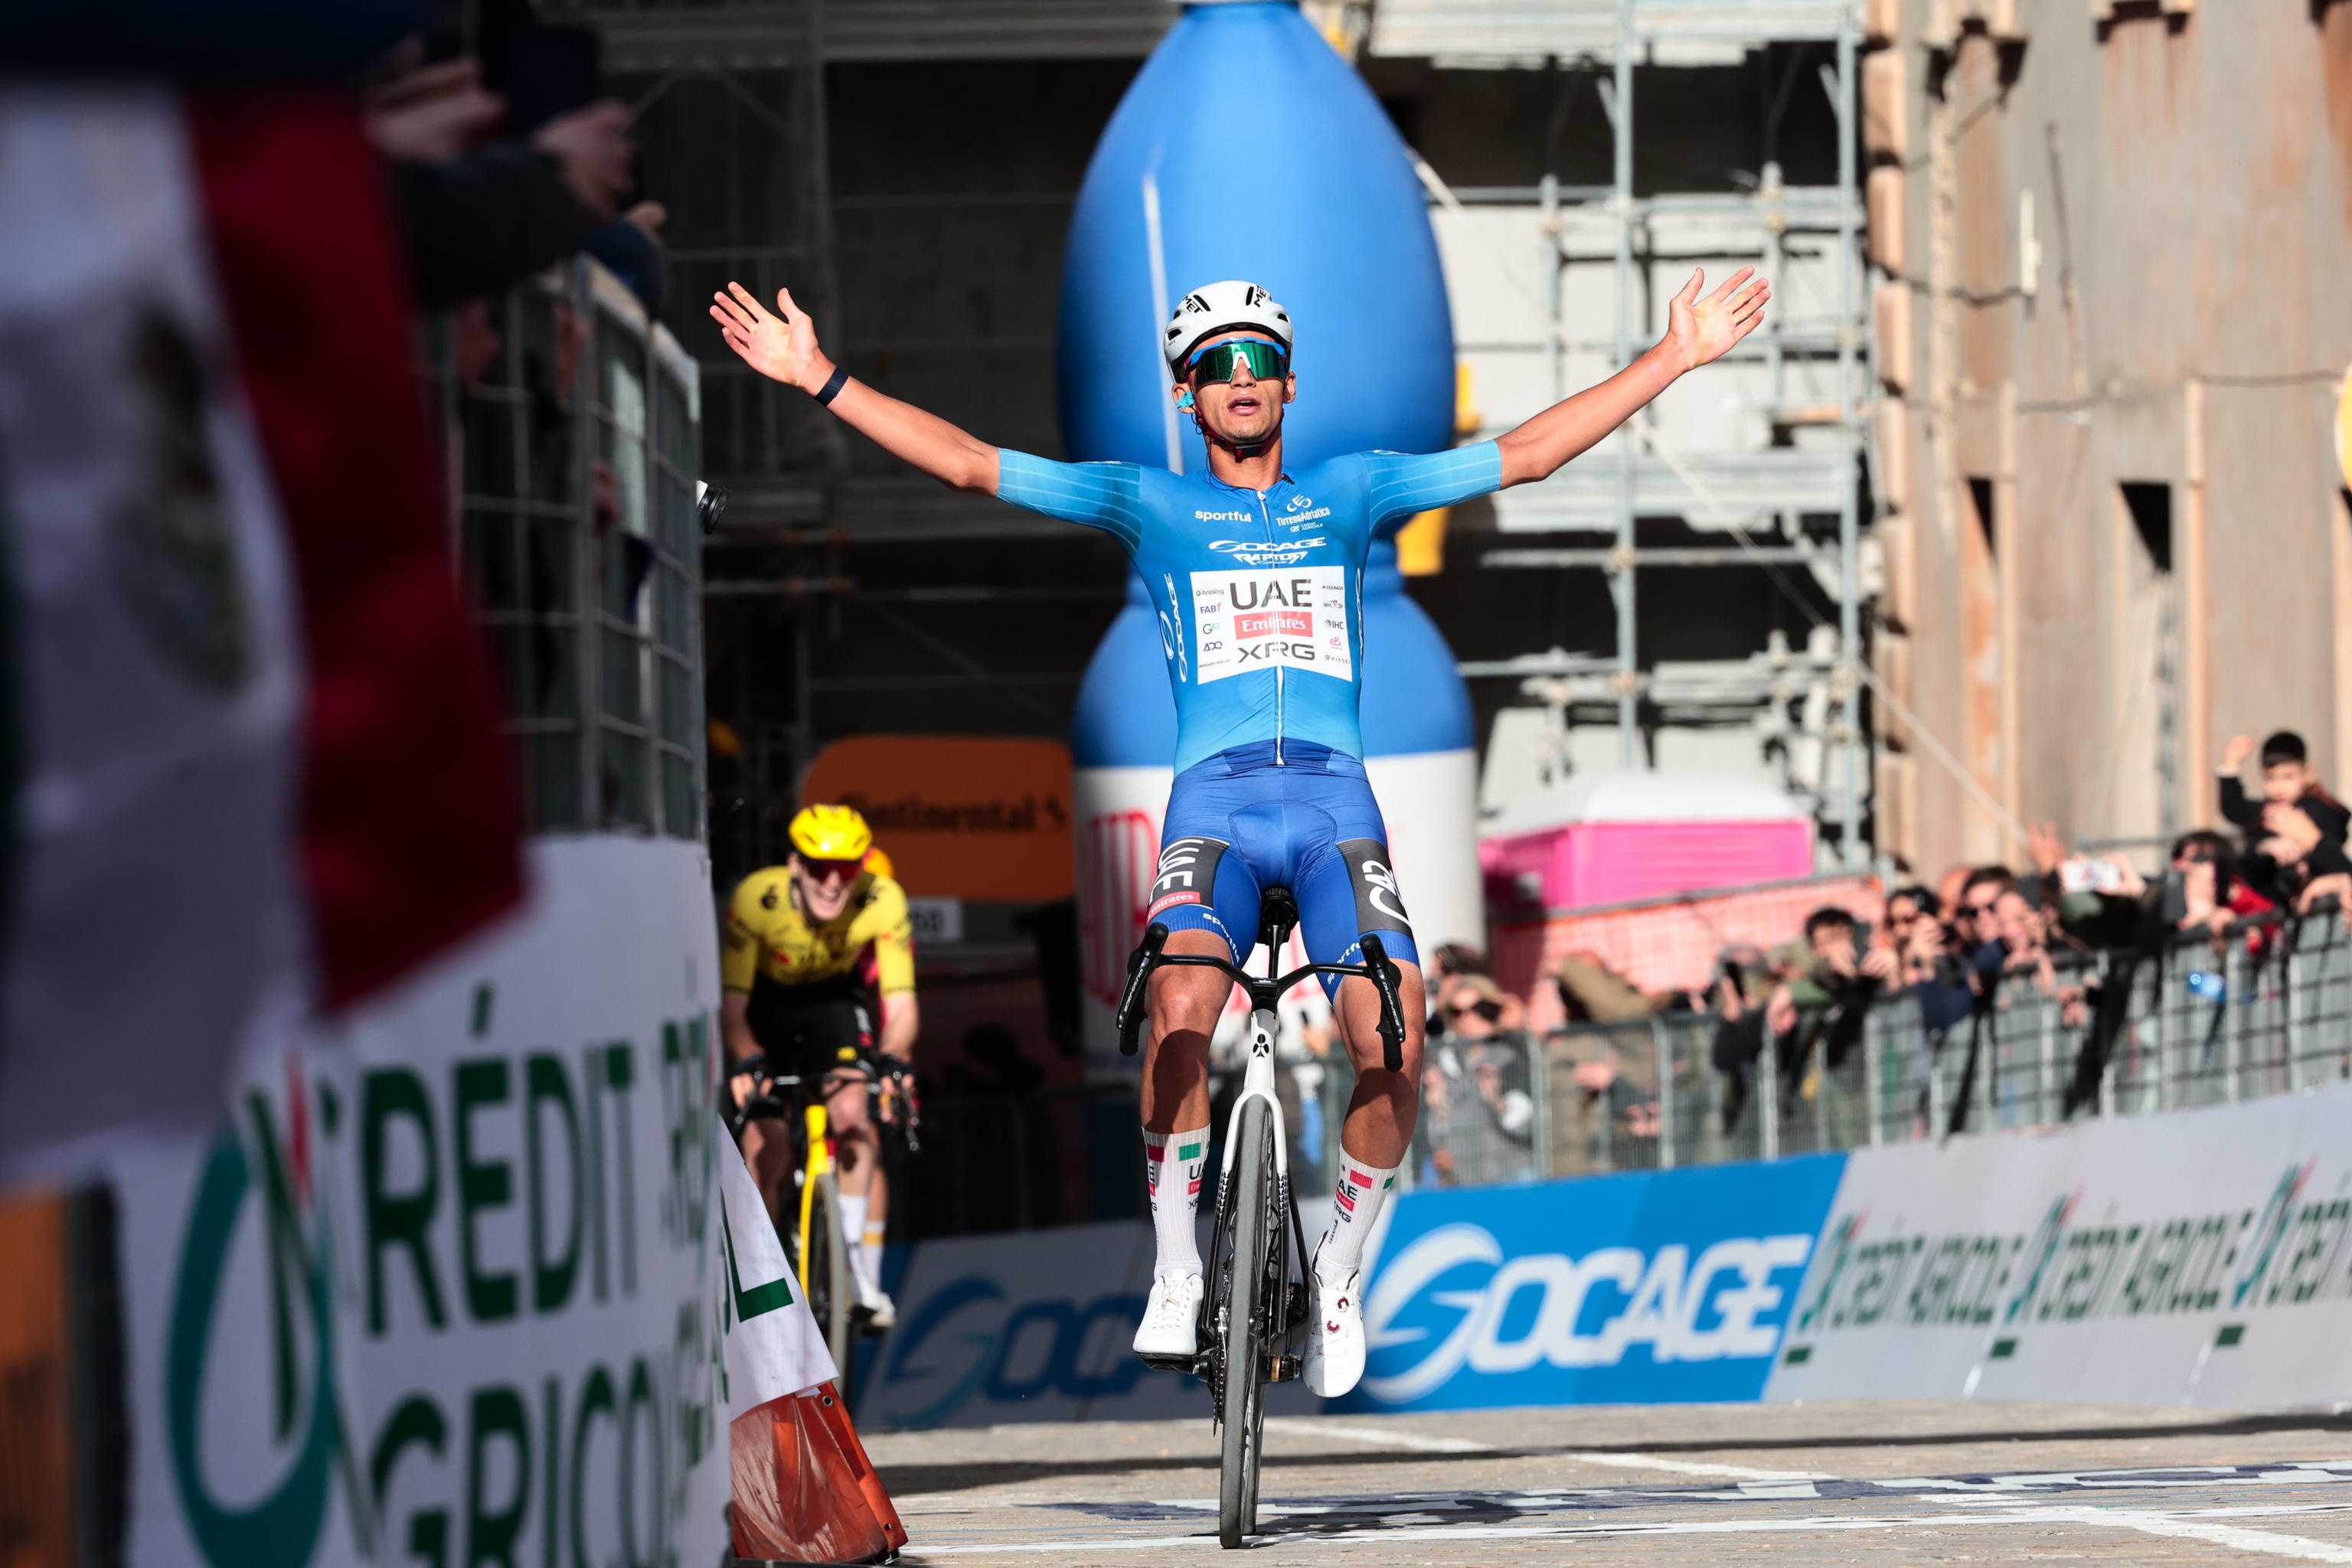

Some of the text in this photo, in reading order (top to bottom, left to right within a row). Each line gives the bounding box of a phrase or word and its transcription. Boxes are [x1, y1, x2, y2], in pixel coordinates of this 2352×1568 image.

[1182, 296, 1204, 314] MET
[1194, 510, 1252, 522] sportful
[1230, 579, 1312, 610] UAE
[1200, 605, 1217, 613] FAB
[1332, 621, 1344, 629] IHC
[1149, 839, 1204, 906] UAE
[1202, 913, 1240, 963] sportful
[1338, 1178, 1358, 1201] AE
